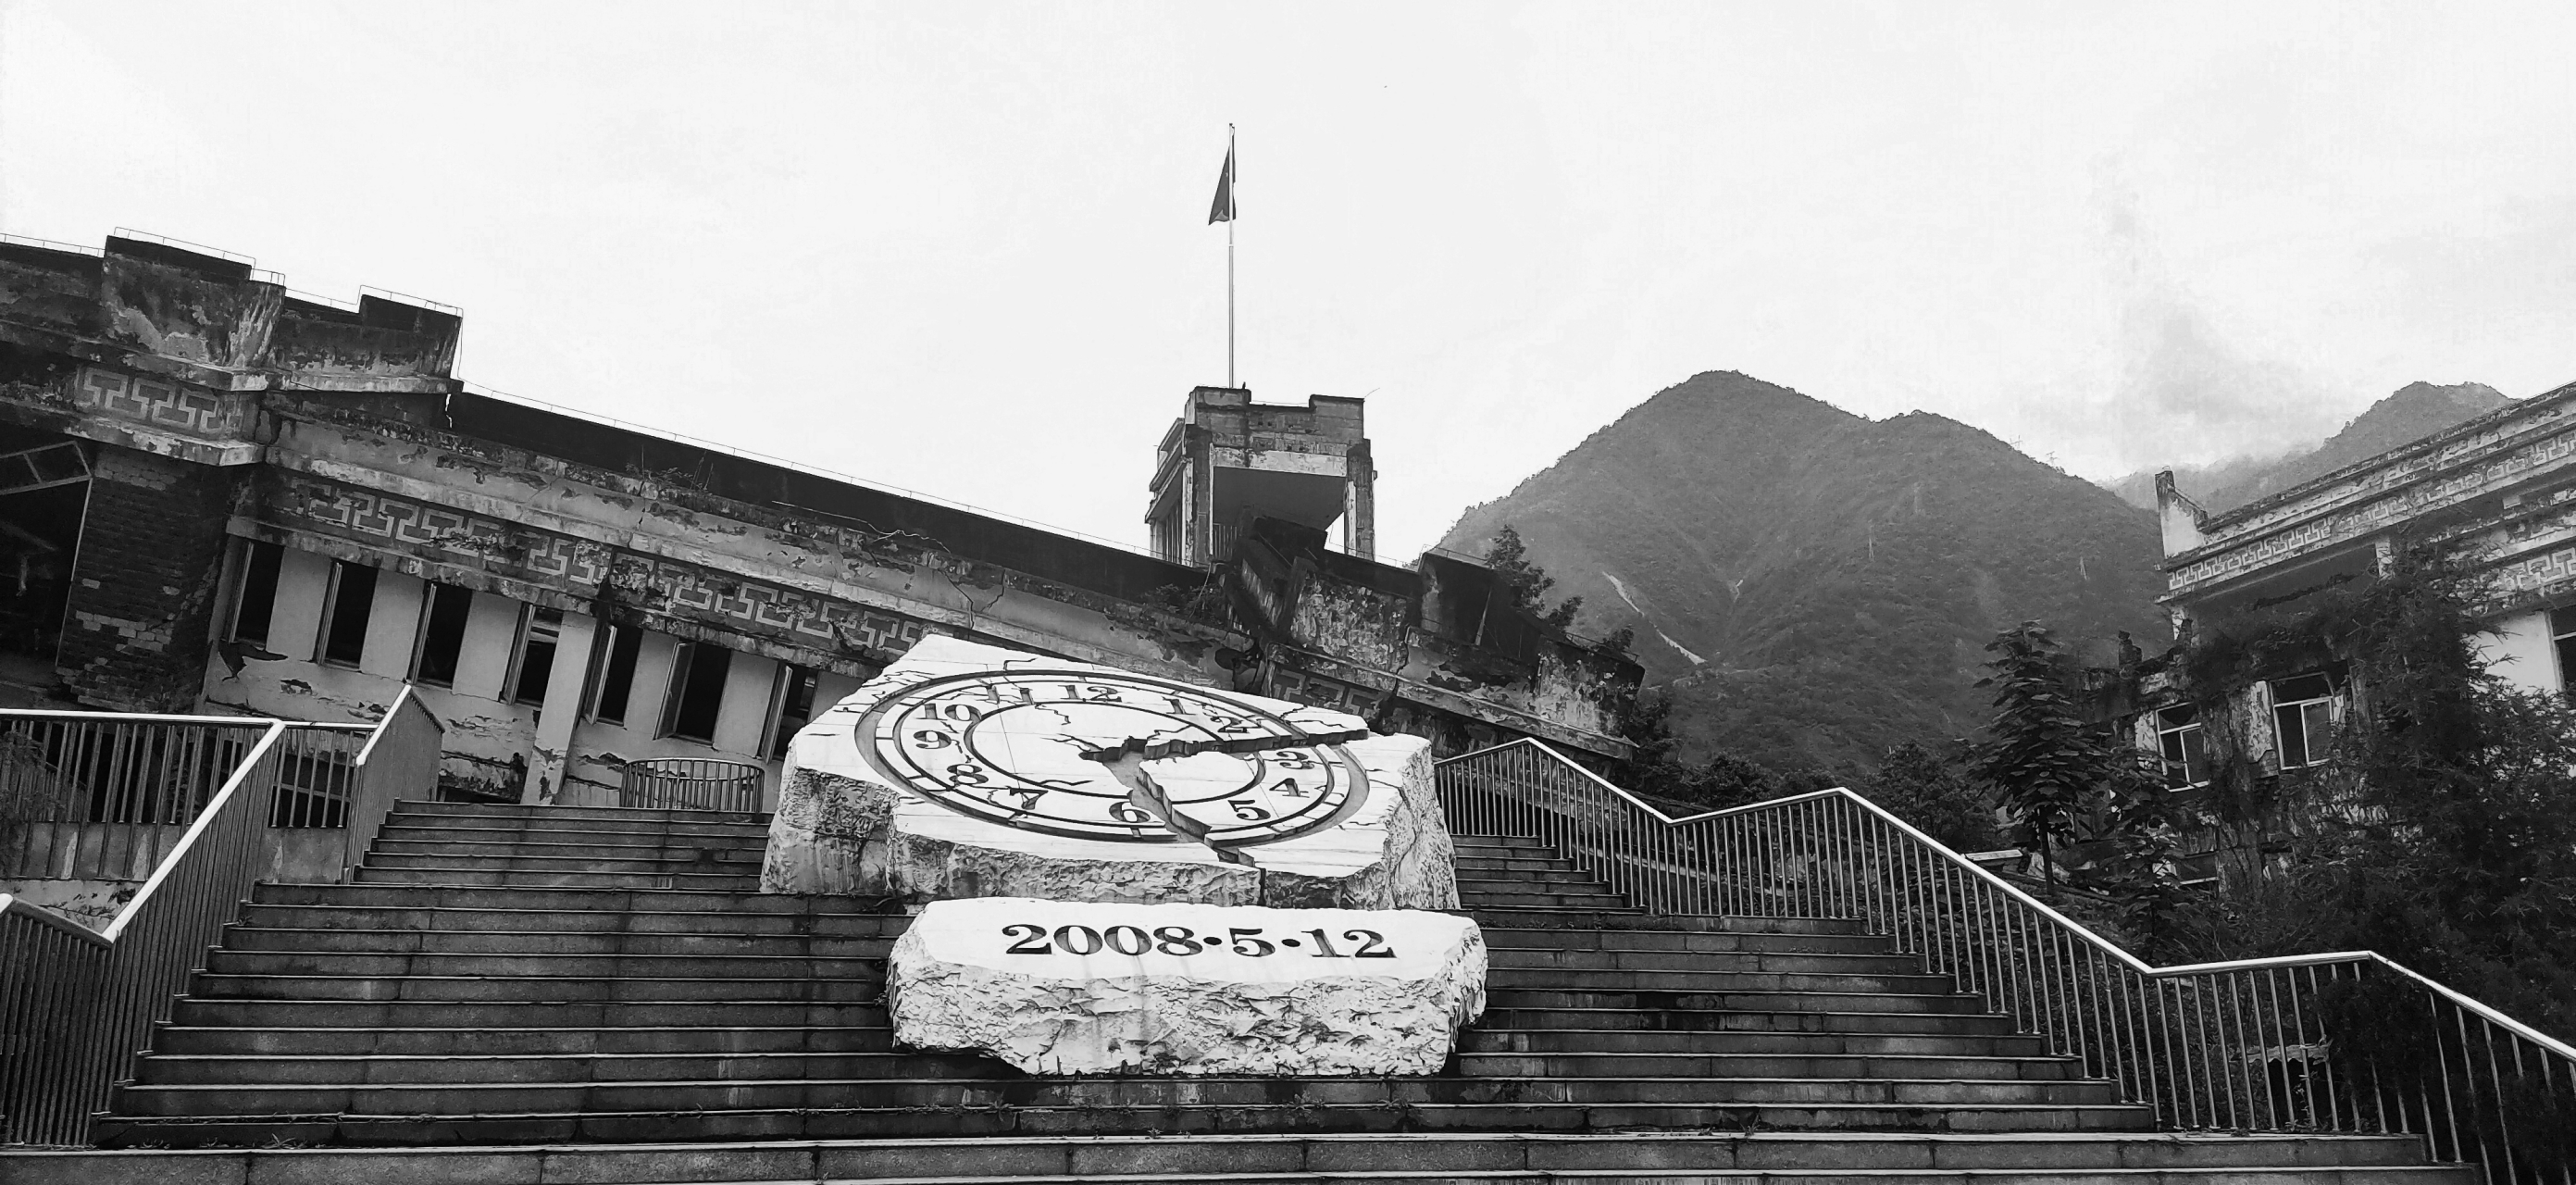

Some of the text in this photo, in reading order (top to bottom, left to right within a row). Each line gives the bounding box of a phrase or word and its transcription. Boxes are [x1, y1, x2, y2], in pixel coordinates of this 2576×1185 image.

[984, 684, 1035, 705] 11
[1059, 683, 1122, 703] 12
[918, 703, 982, 723] 10
[1165, 697, 1198, 716] 1
[1209, 715, 1249, 734] 2
[913, 730, 952, 750] 9
[1276, 750, 1315, 769] 3
[946, 763, 989, 787] 8
[1269, 777, 1308, 798] 4
[1009, 788, 1049, 810] 7
[1109, 801, 1151, 824] 6
[1226, 799, 1272, 821] 5
